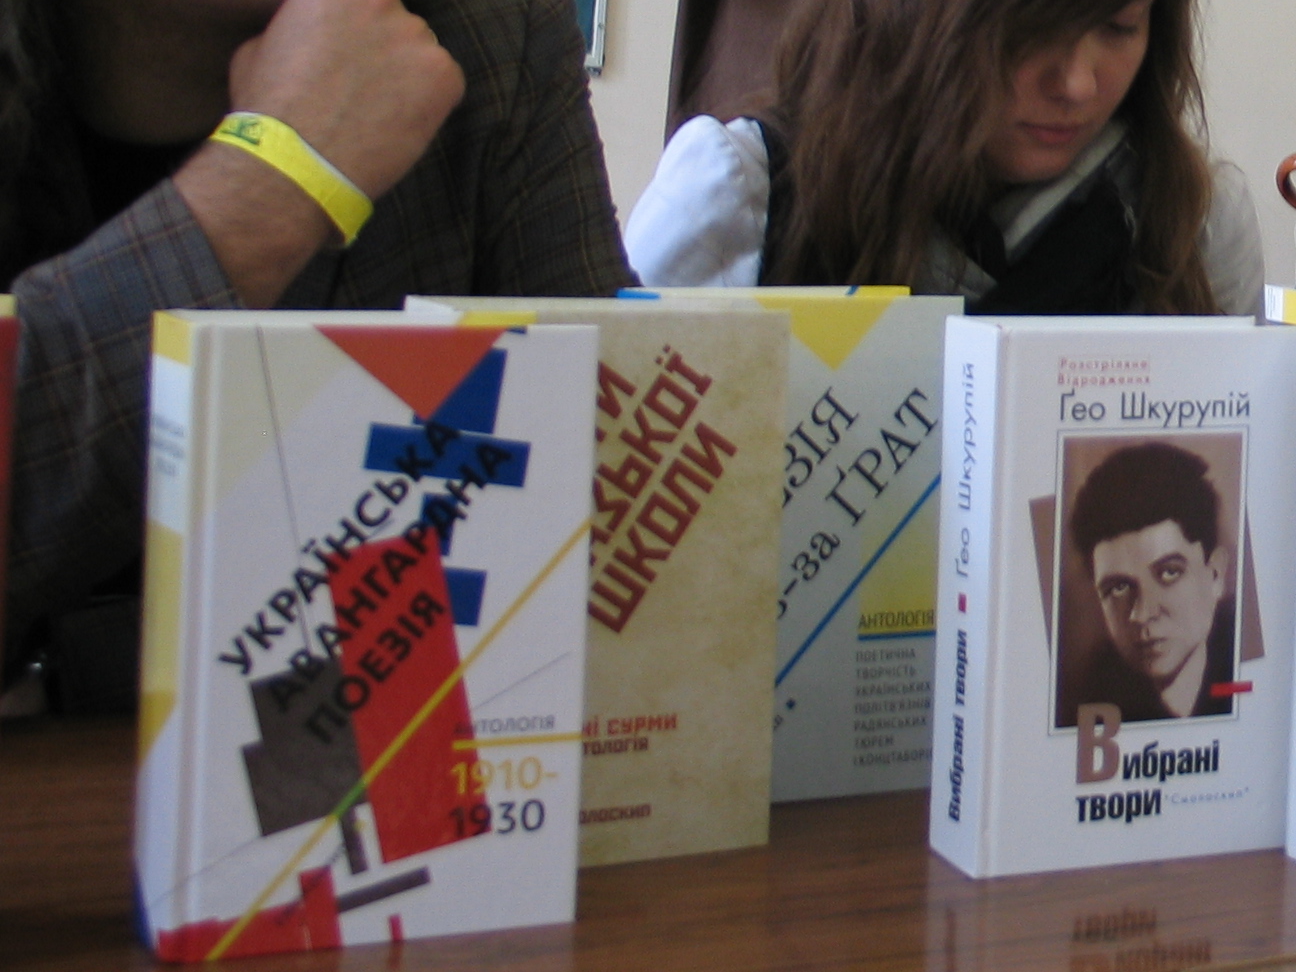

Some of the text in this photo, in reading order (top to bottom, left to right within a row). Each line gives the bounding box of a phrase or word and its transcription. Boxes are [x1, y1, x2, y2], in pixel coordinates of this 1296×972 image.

[590, 343, 713, 567] ЗЬКОЇ
[782, 385, 860, 509] ЗІЯ
[958, 363, 977, 511] Шкурупій
[1059, 388, 1251, 428] Ґео Шкурупій
[217, 421, 461, 676] УКРАЇНСЬКА
[267, 443, 513, 714] АВАНГАРДНА
[586, 421, 738, 634] ШКОЛИ
[304, 591, 448, 745] ПОЕЗІЯ
[858, 609, 936, 629] АНТОЛОГІЯ
[955, 629, 968, 707] твори
[949, 712, 965, 823] Вибрані
[1076, 702, 1220, 784] Вибрані
[450, 799, 546, 839] 1930
[1076, 789, 1161, 823] твори
